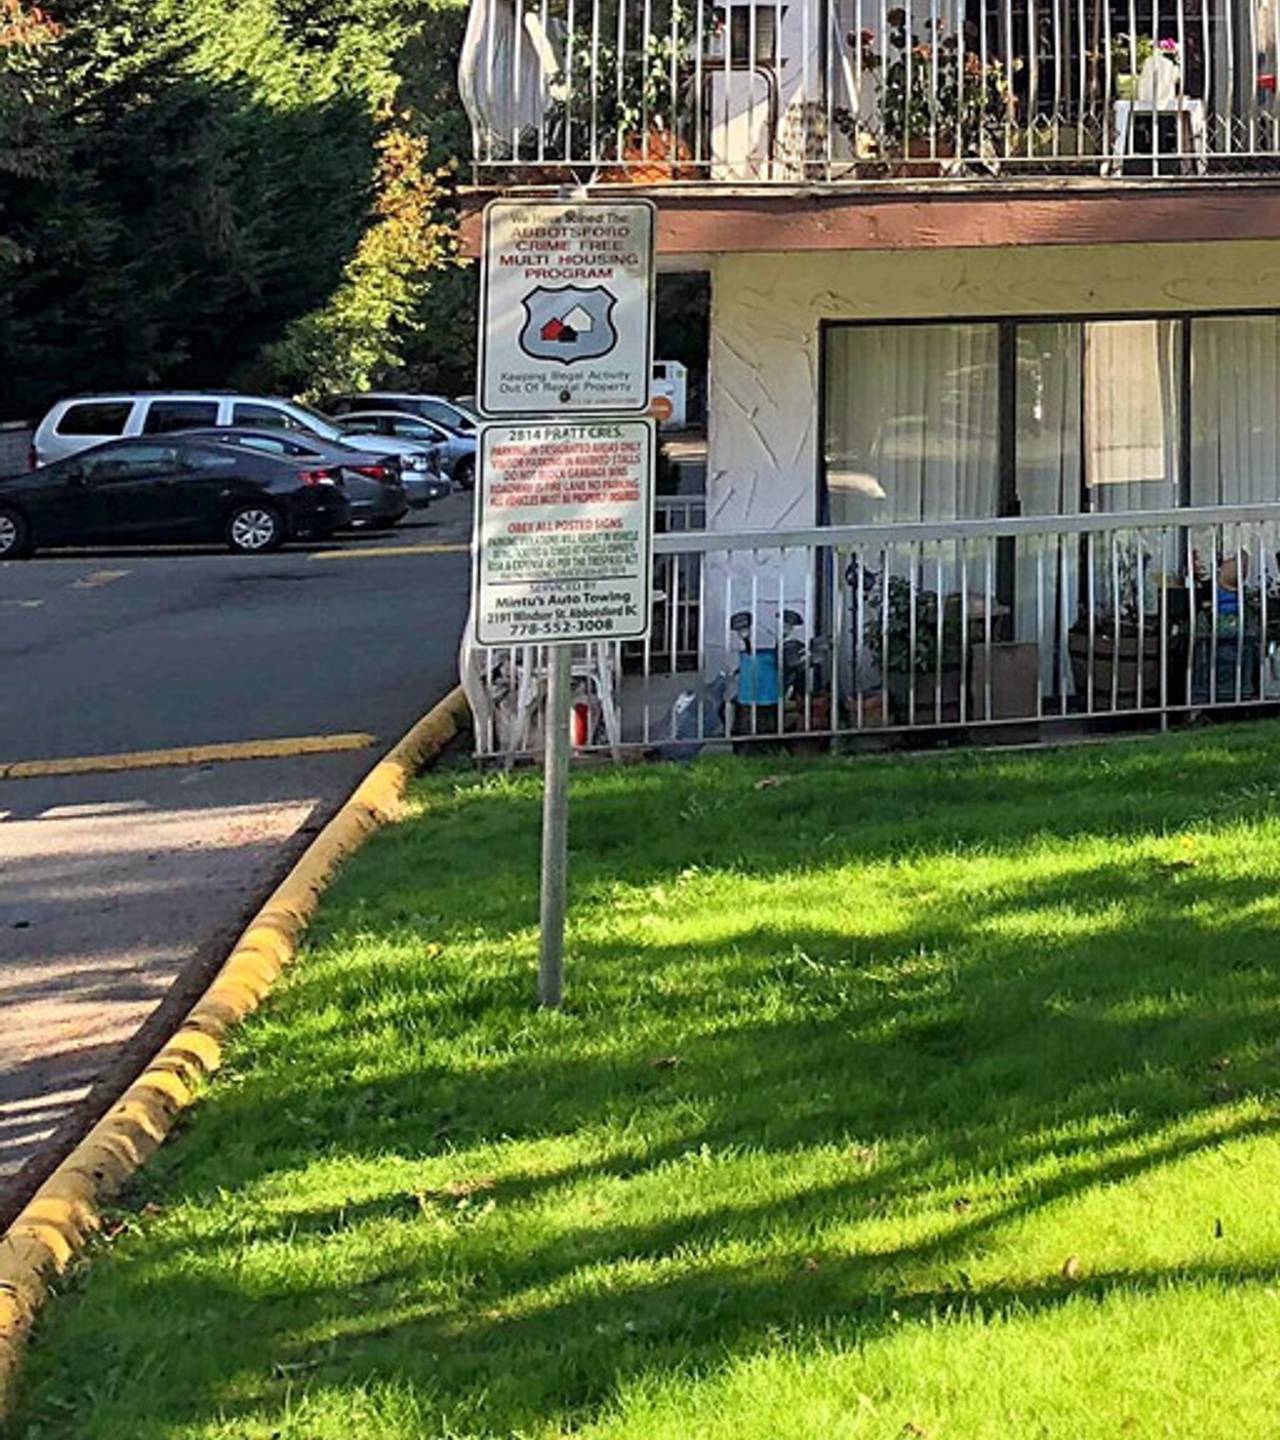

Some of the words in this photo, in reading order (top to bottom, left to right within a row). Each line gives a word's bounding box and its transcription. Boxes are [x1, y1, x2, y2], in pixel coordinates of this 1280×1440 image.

[512, 227, 629, 238] ABBOTSFORD
[515, 241, 570, 251] CRIME
[580, 240, 623, 251] FREE
[500, 255, 549, 266] MULTI
[559, 254, 638, 265] HOUSING
[525, 268, 613, 279] PROGRAM
[501, 372, 546, 383] Keeping
[551, 371, 584, 382] Illegal
[588, 371, 629, 381] Activity
[500, 383, 521, 393] Out
[525, 383, 538, 392] Of
[584, 382, 631, 392] Property
[510, 430, 540, 441] 2814
[545, 428, 584, 440] PRATT
[508, 522, 533, 534] OBEY
[535, 521, 553, 532] ALL
[555, 520, 593, 532] POSTED
[595, 518, 623, 529] SIGNS
[496, 596, 544, 608] Mintu's
[548, 595, 581, 606] Auto
[583, 591, 631, 604] Towing
[509, 619, 613, 636] 778-552-3008
